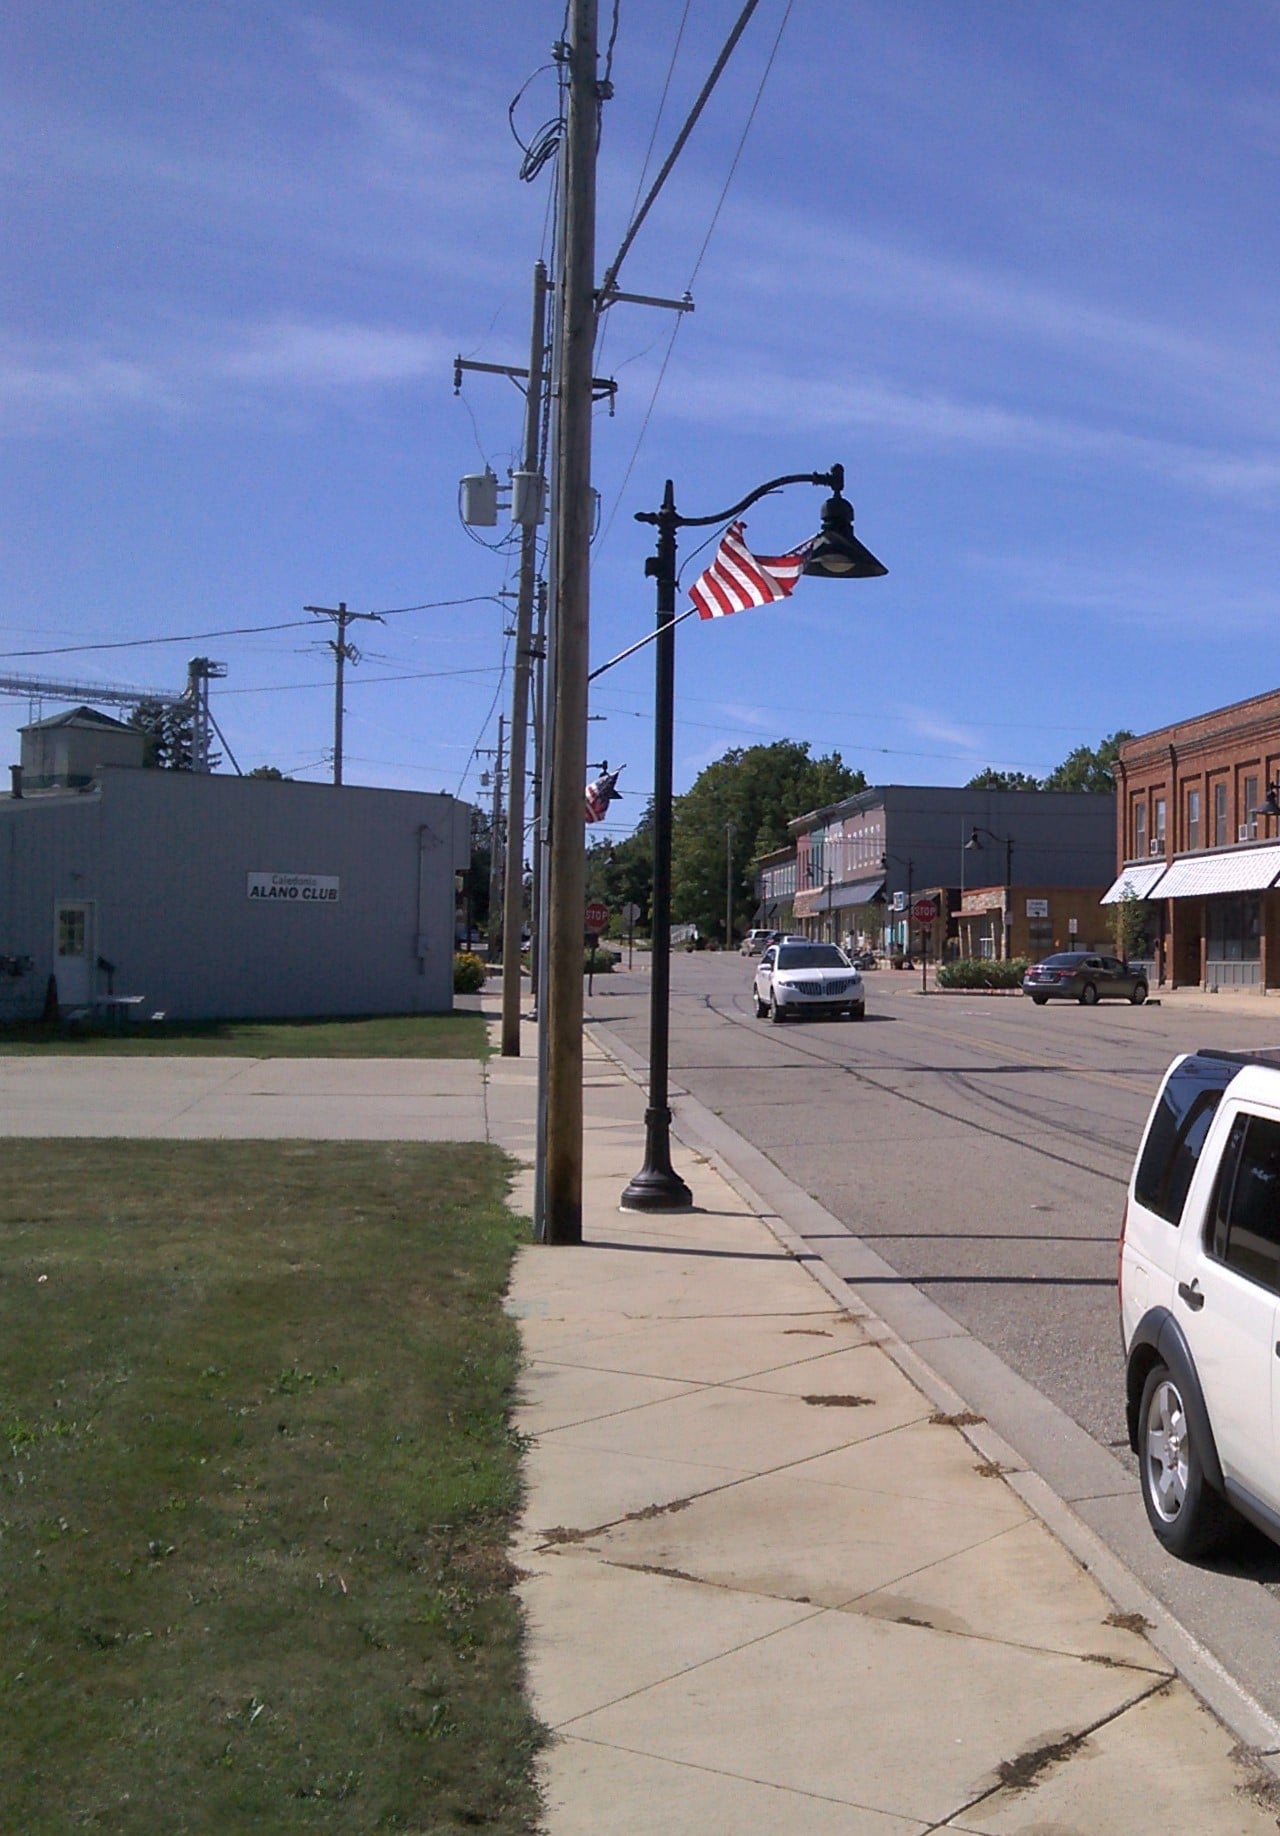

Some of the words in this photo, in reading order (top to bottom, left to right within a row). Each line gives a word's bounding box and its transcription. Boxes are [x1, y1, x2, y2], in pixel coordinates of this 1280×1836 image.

[272, 875, 318, 886] Caledonia
[250, 886, 298, 898] ALANO
[302, 888, 338, 900] CLUB
[585, 910, 608, 920] STOP
[914, 906, 936, 916] STOP
